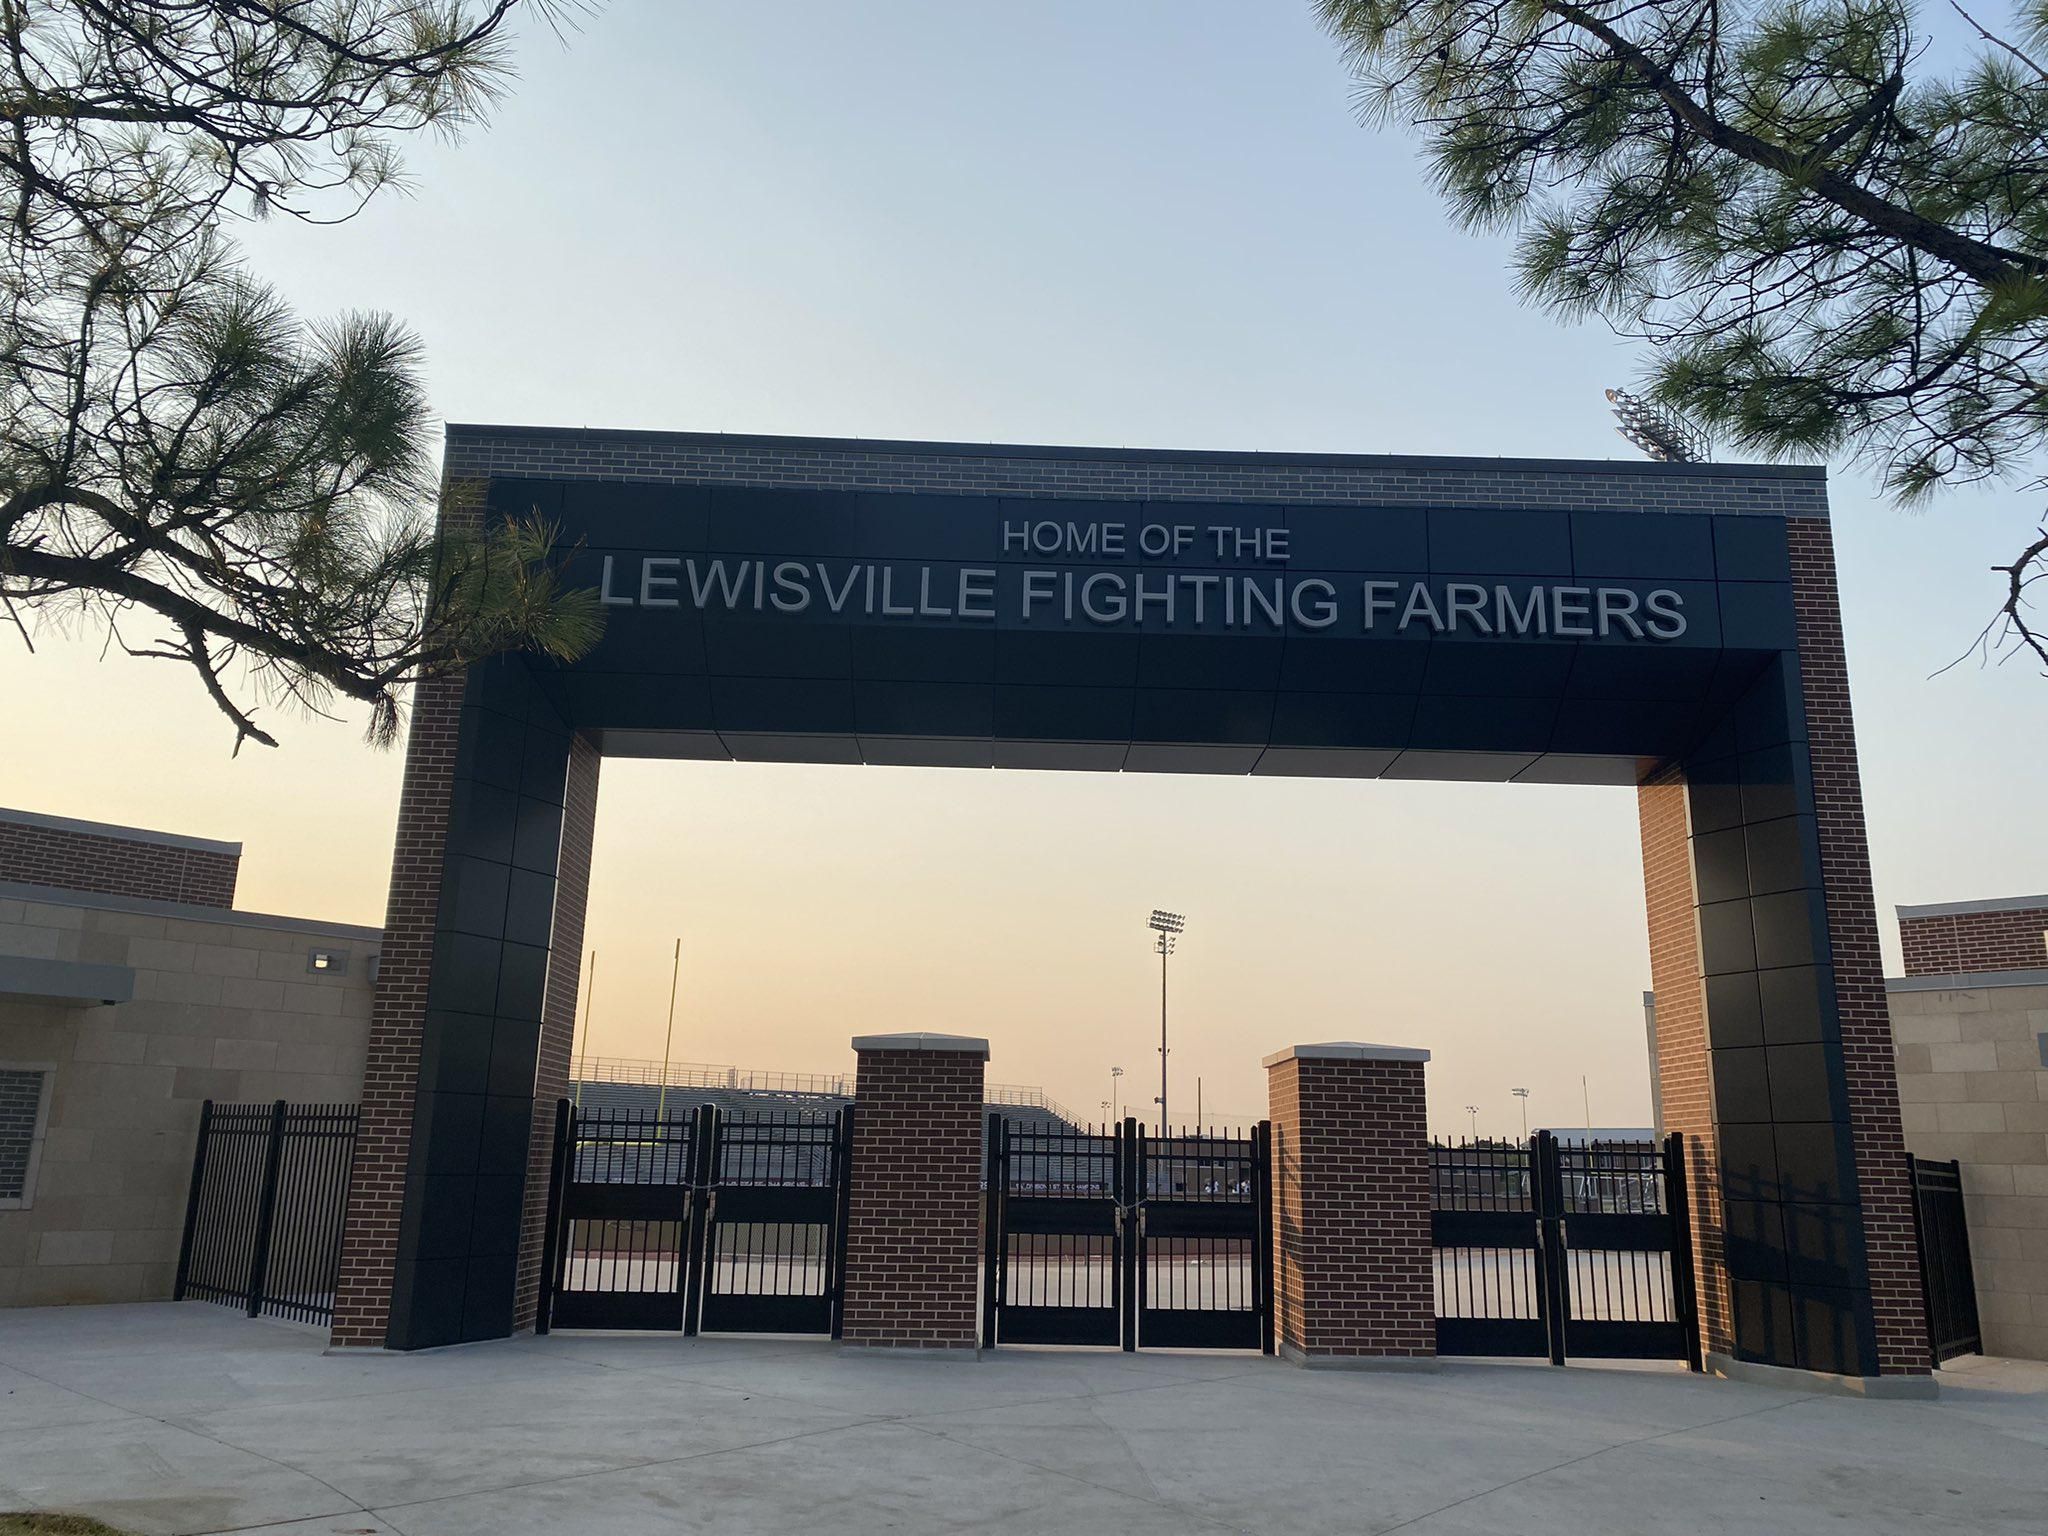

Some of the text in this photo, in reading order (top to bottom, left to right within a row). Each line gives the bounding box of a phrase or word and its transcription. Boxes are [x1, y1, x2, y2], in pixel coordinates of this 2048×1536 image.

[1003, 520, 1291, 560] HOME OF THE
[600, 555, 1688, 640] LEWISVILLE FIGHTING FARMERS
